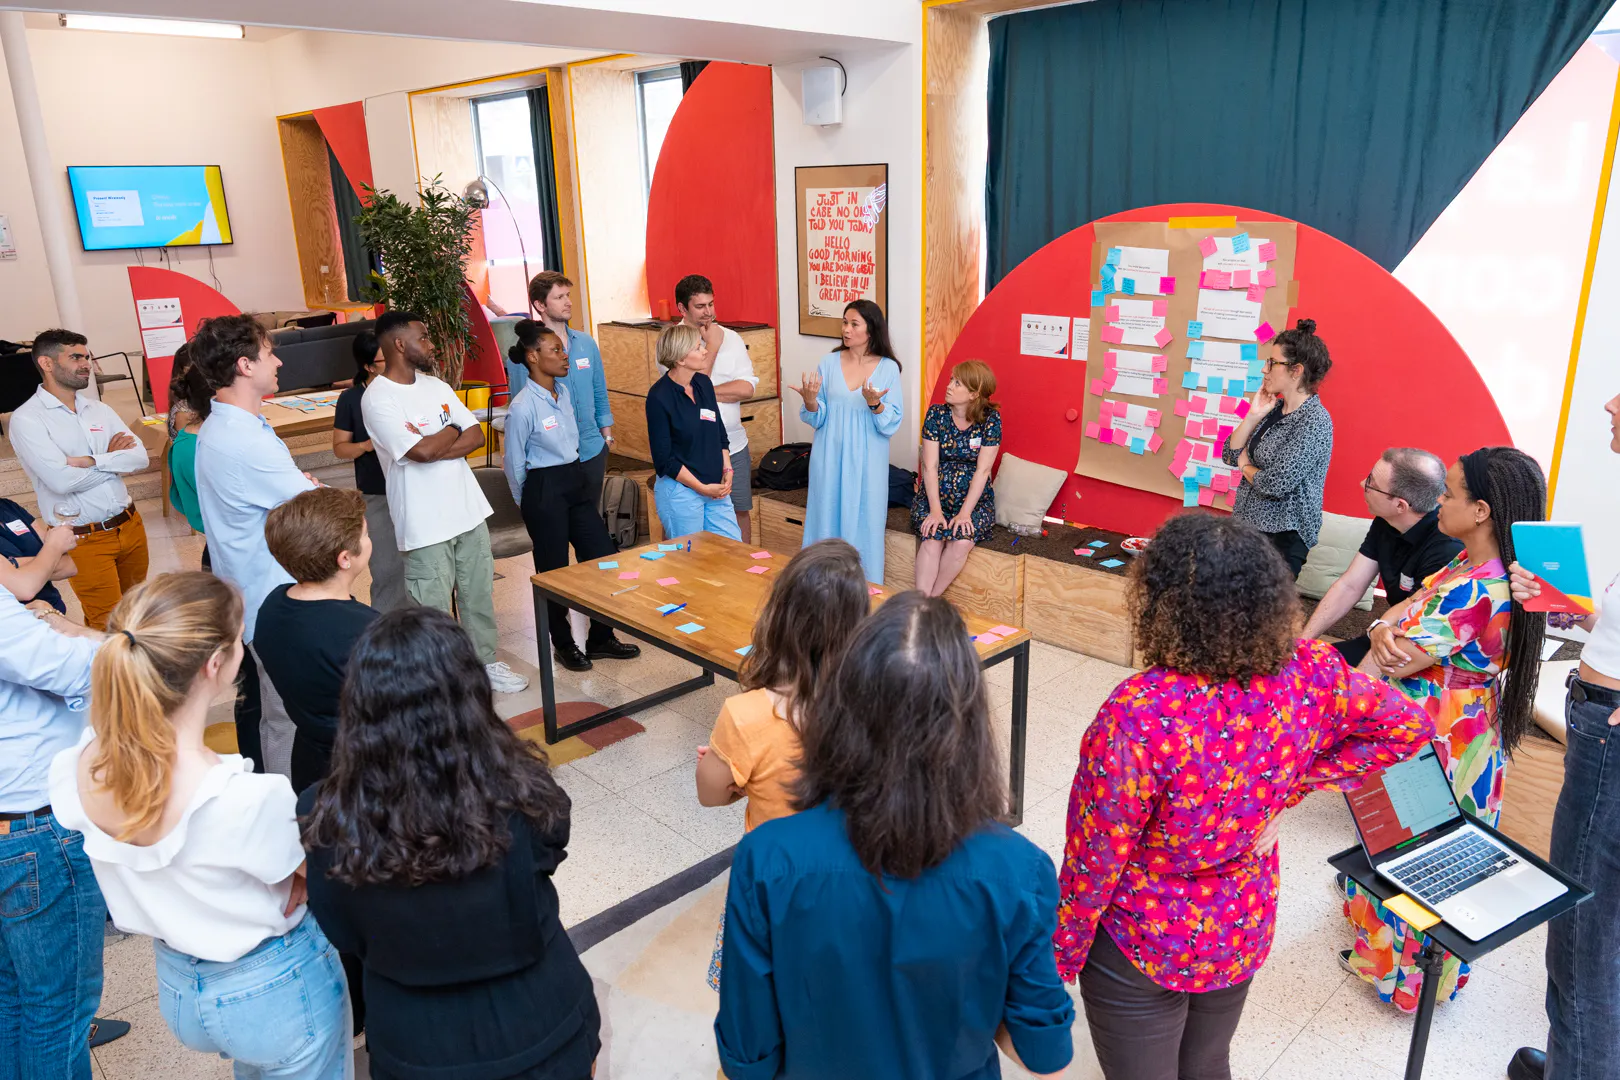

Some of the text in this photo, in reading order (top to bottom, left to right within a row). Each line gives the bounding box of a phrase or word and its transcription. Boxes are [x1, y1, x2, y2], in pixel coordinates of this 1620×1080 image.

[810, 206, 832, 218] CASE
[836, 205, 850, 218] NO
[829, 218, 844, 232] YOU
[824, 235, 850, 251] HELLO
[808, 248, 830, 261] GOOD
[821, 260, 834, 272] ARE
[815, 274, 818, 285] I
[819, 287, 842, 302] GREAT
